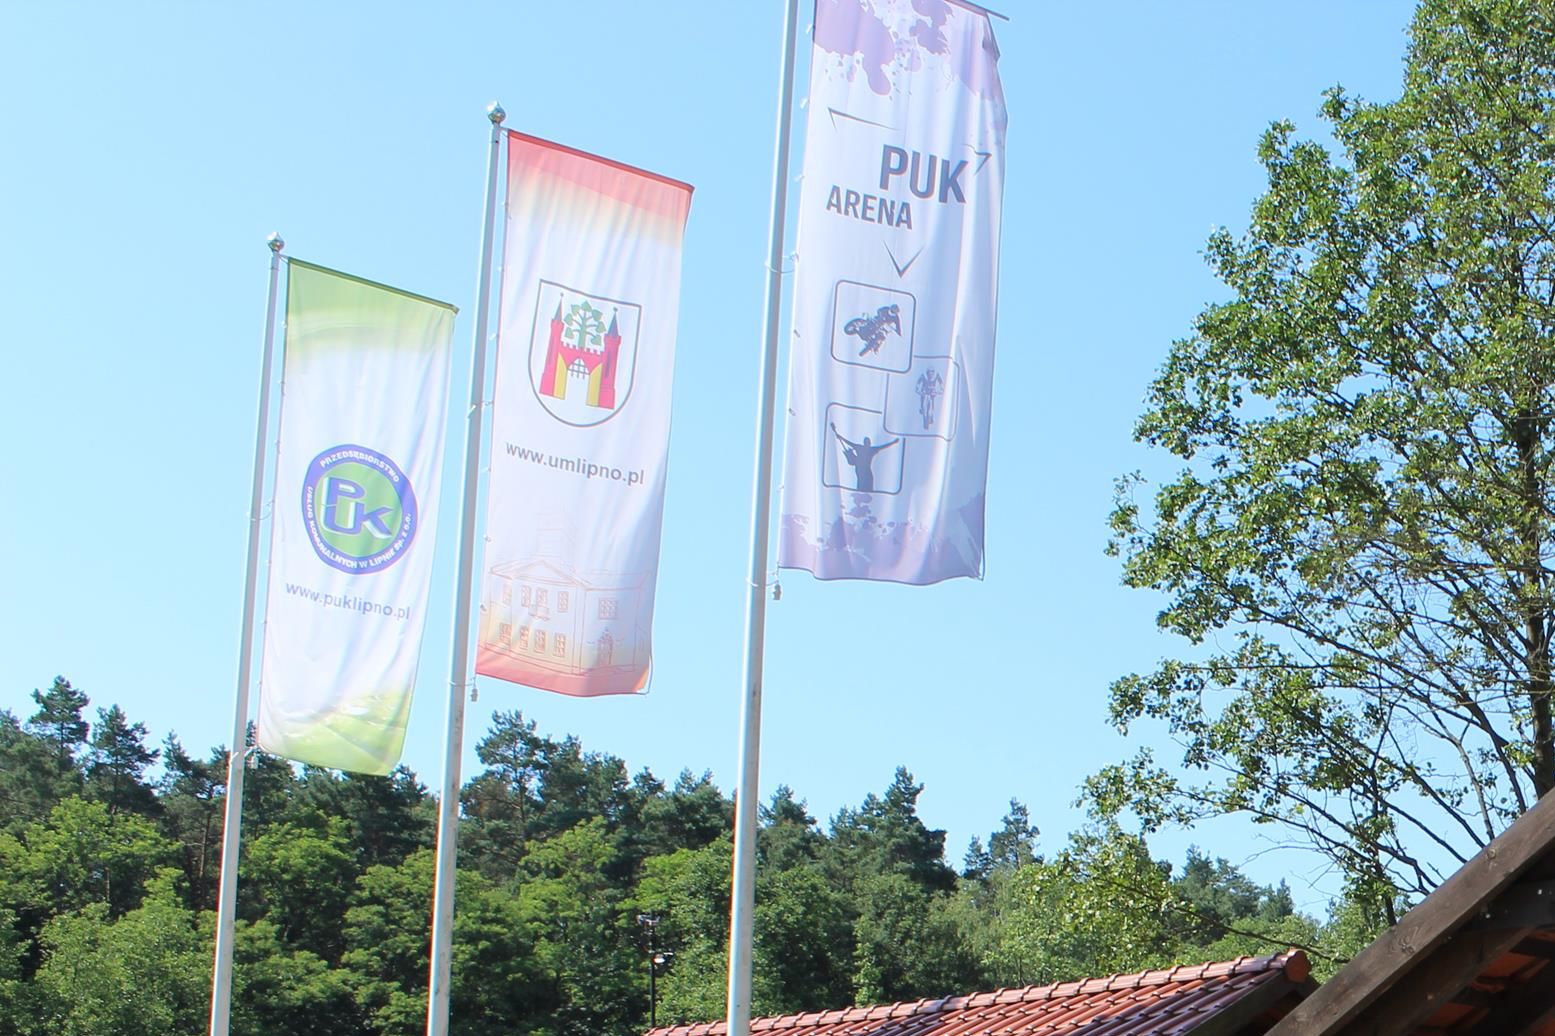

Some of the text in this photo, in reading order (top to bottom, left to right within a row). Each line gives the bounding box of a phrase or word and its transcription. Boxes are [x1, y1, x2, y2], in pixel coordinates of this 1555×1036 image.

[879, 143, 969, 204] PUK
[826, 184, 913, 230] ARENA
[505, 441, 645, 486] www.umlipno.pl
[285, 582, 411, 621] www.puklipno.pl
